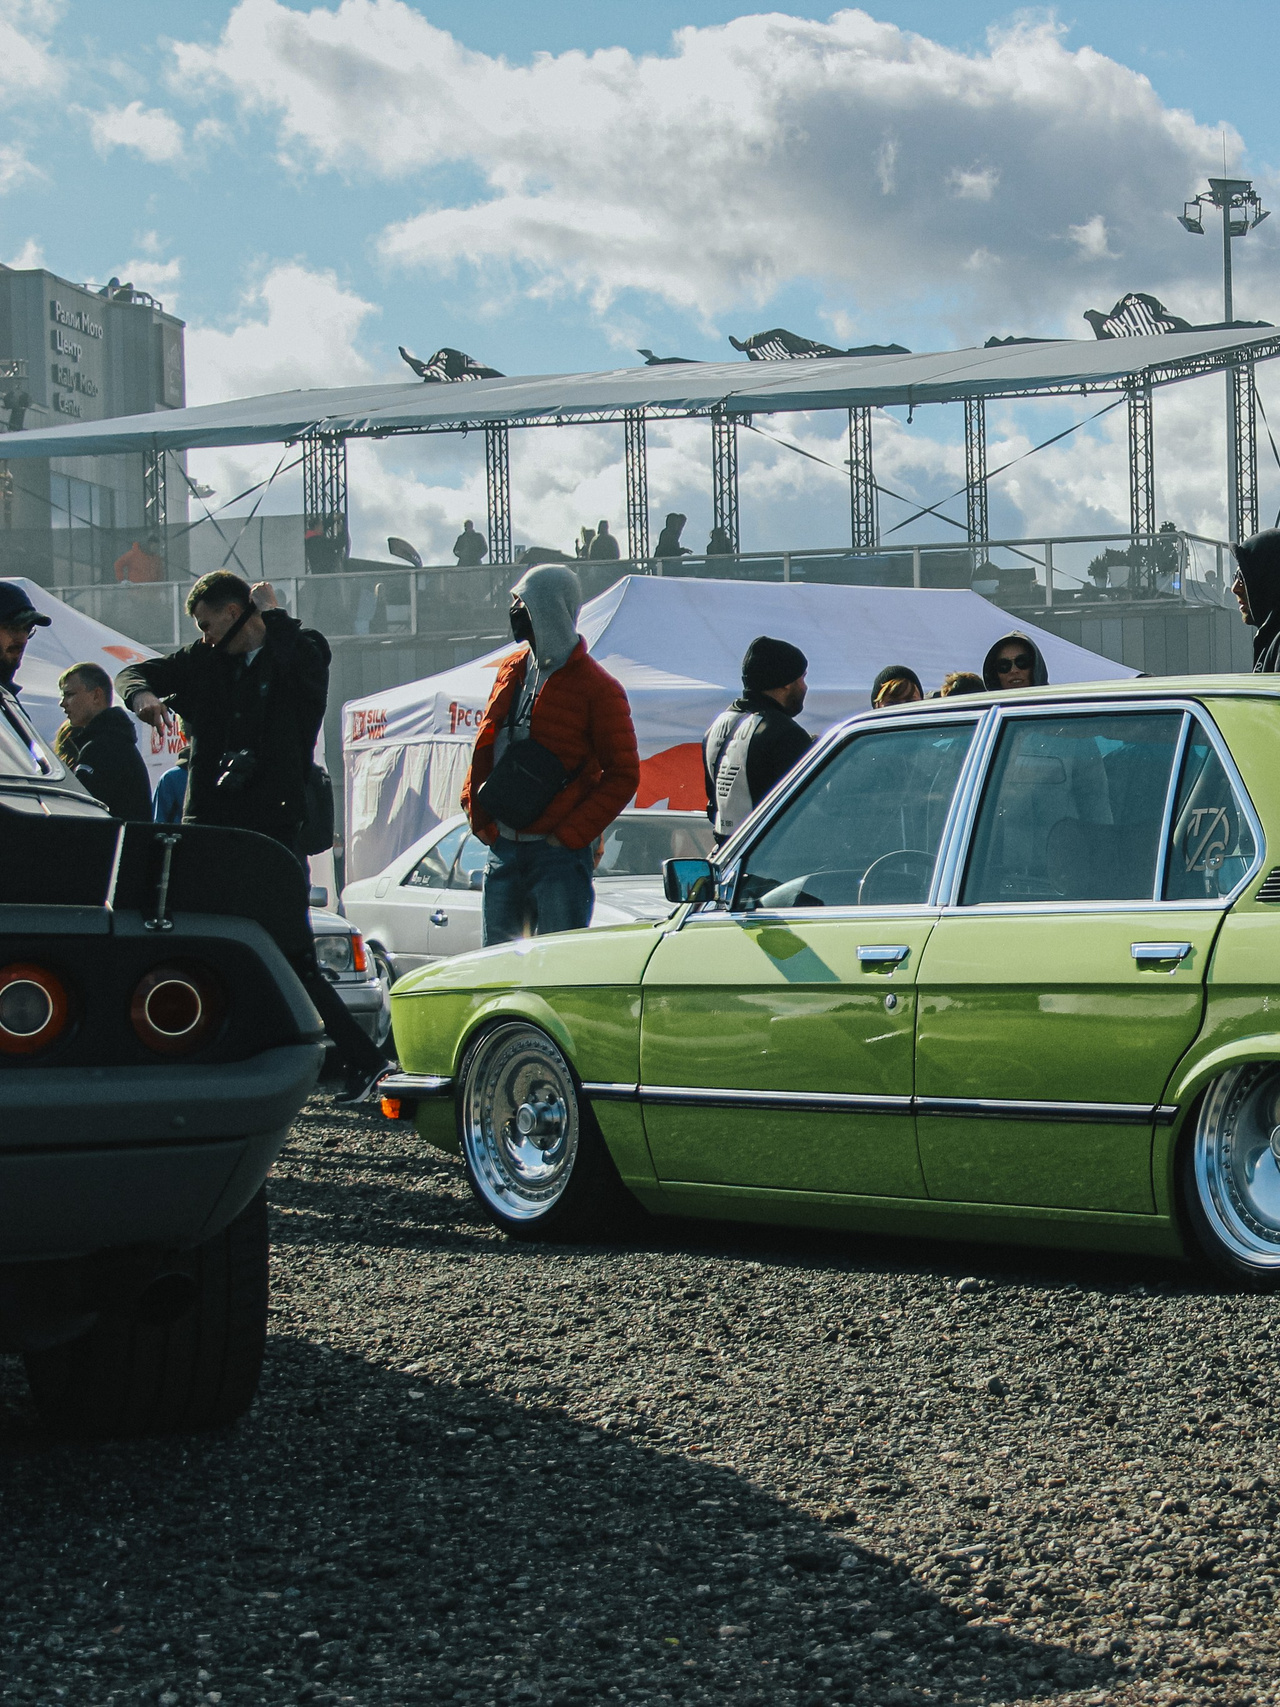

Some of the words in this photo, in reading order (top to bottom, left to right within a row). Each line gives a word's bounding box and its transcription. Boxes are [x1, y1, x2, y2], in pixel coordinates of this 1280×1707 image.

[55, 300, 82, 330] Ралли
[81, 311, 104, 340] Мото
[56, 330, 83, 362] Центр
[366, 708, 388, 724] SILK
